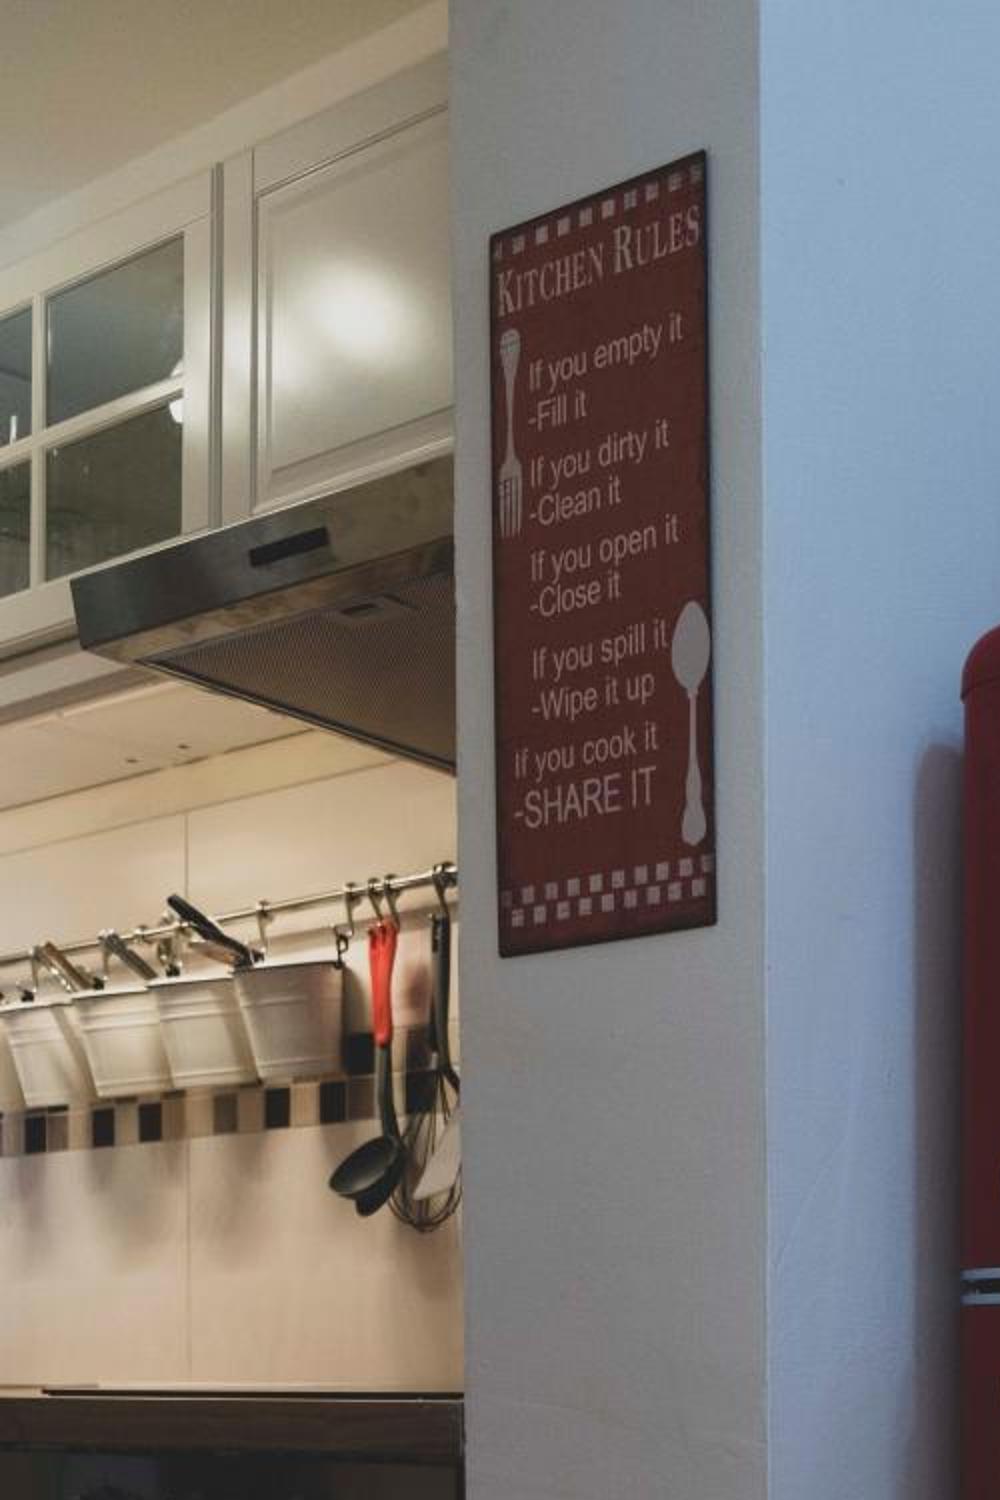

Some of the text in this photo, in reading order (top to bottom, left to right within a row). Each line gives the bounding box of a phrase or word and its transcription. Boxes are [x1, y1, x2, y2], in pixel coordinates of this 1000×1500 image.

[497, 204, 700, 317] KITCHEN RULES
[529, 312, 684, 394] If you empty it
[528, 389, 587, 432] -Fill it
[530, 418, 669, 491] If you dirty it
[529, 477, 622, 527] -Clean it
[530, 515, 679, 581] If you open it
[530, 572, 622, 618] -Close it
[532, 619, 668, 680] If you spill it
[531, 673, 655, 722] -Wipe it up
[514, 721, 659, 783] If you cook it
[513, 766, 657, 830] -SHARE IT
